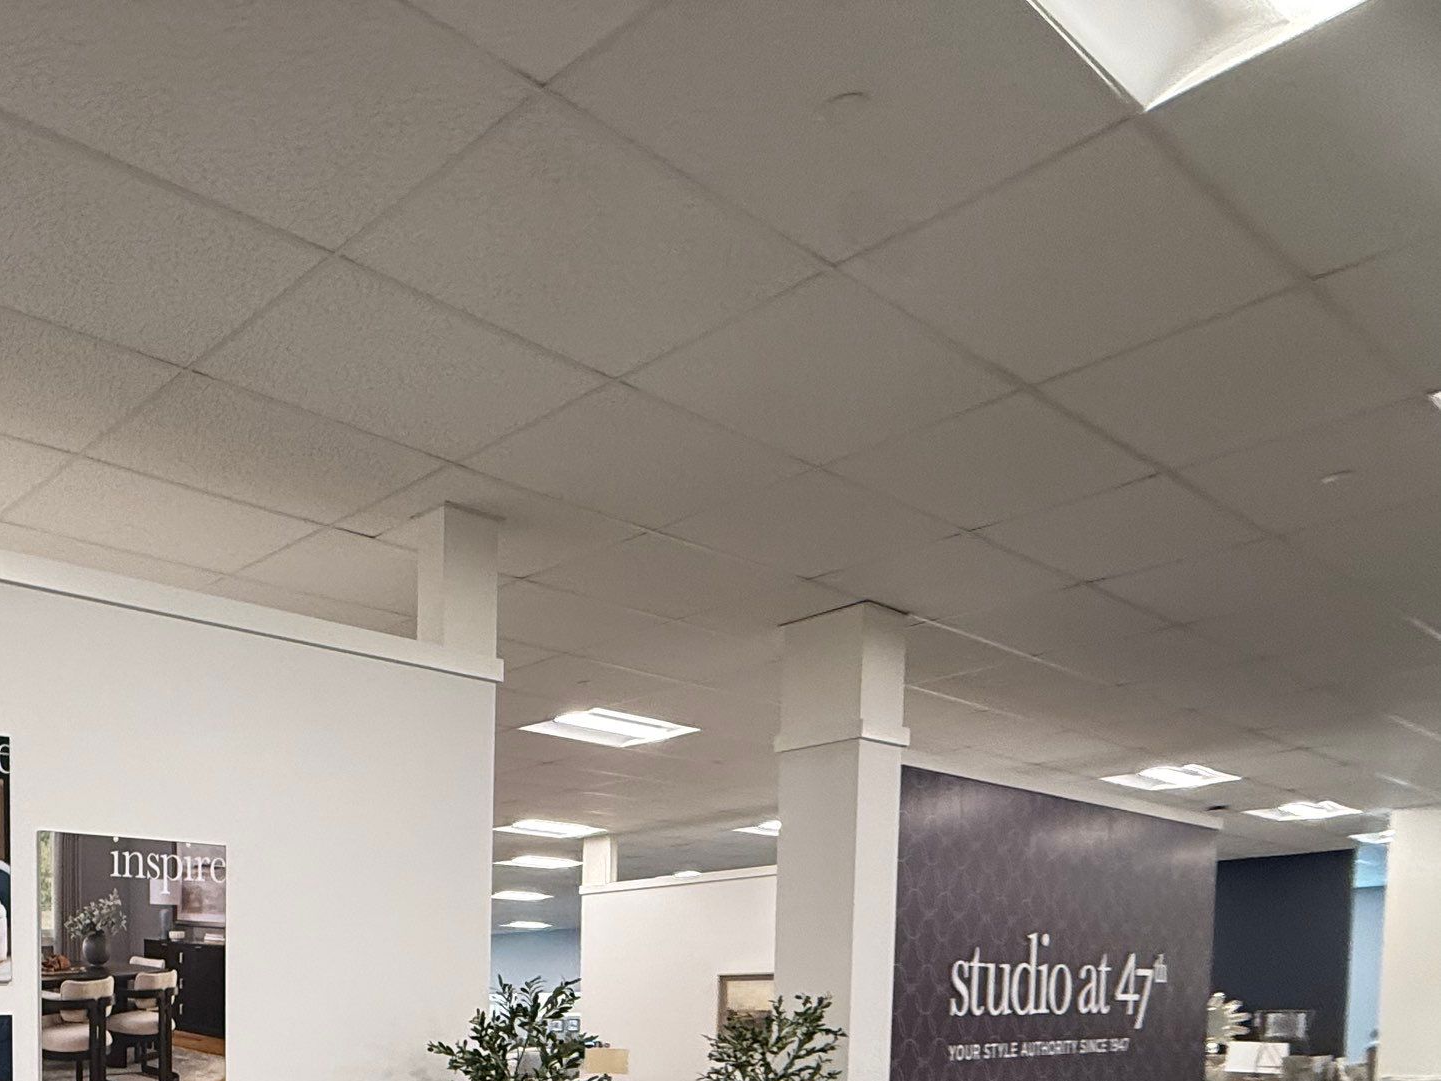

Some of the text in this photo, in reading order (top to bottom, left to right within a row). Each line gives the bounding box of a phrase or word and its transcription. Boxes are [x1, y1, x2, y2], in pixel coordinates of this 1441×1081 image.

[110, 836, 226, 895] inspire
[950, 932, 1073, 1016] studio
[1078, 953, 1112, 1015] at
[947, 1043, 981, 1062] YOUR
[983, 1041, 1018, 1060] STYLE
[1020, 1039, 1077, 1057] AUTHORITY
[1079, 1038, 1107, 1054] SINCE
